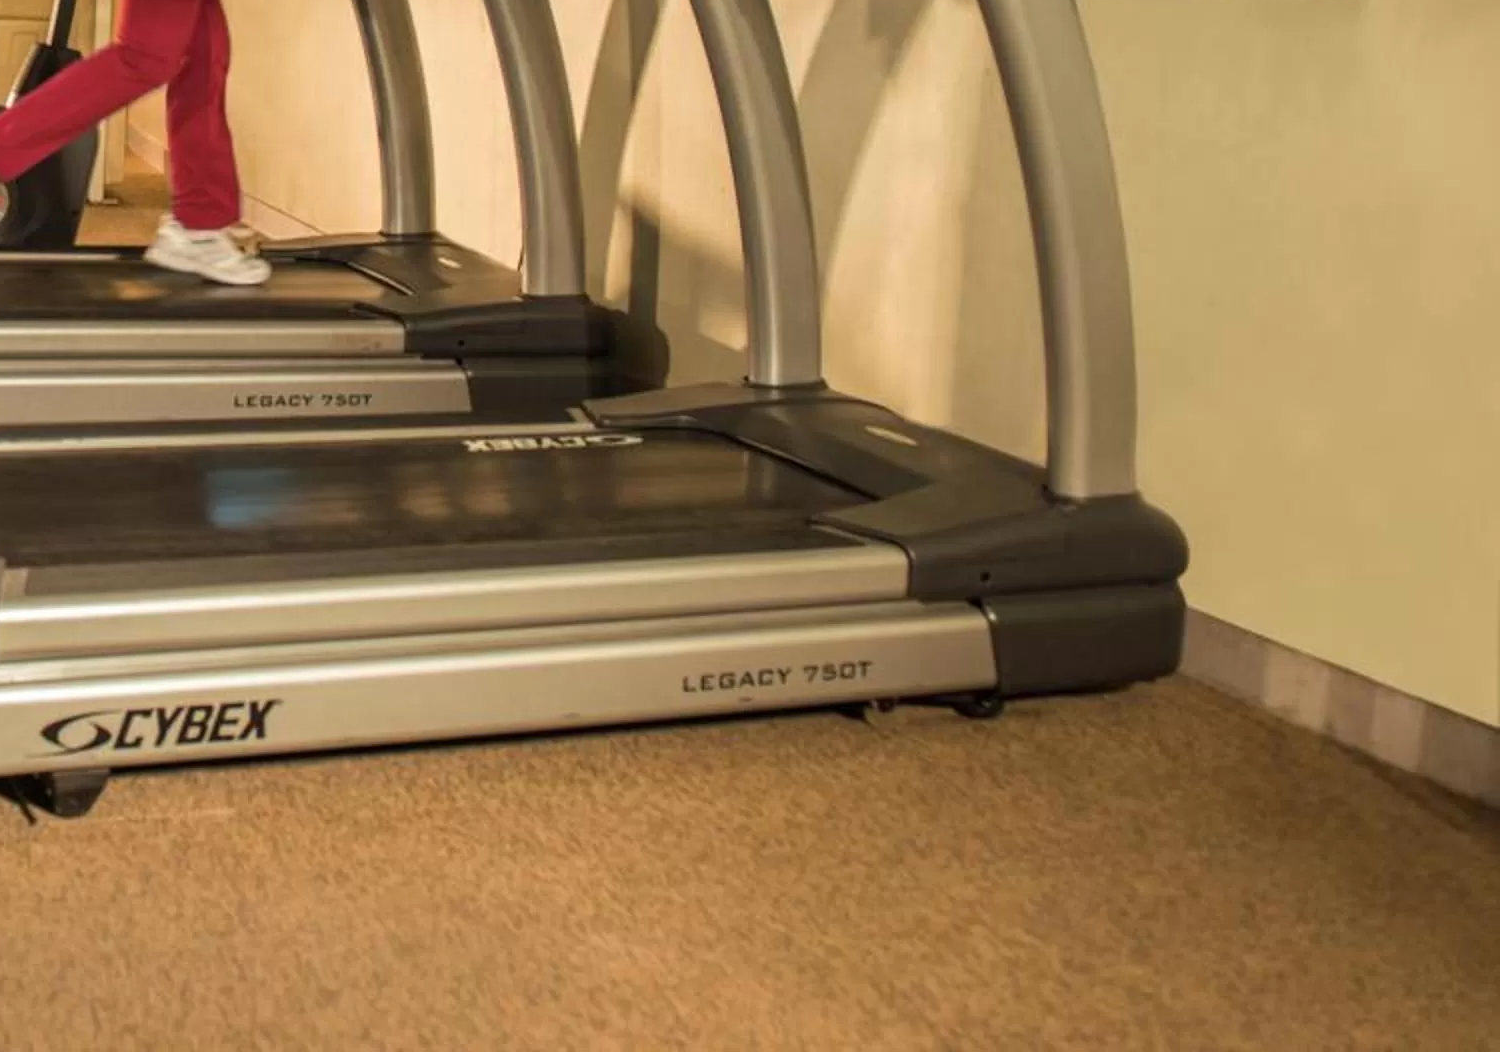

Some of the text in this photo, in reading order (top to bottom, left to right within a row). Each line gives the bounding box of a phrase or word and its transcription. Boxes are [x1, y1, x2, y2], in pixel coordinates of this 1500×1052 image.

[233, 394, 373, 408] LEGACY 750T
[682, 661, 873, 693] LEGACY 750T
[113, 699, 284, 750] CYBEX
